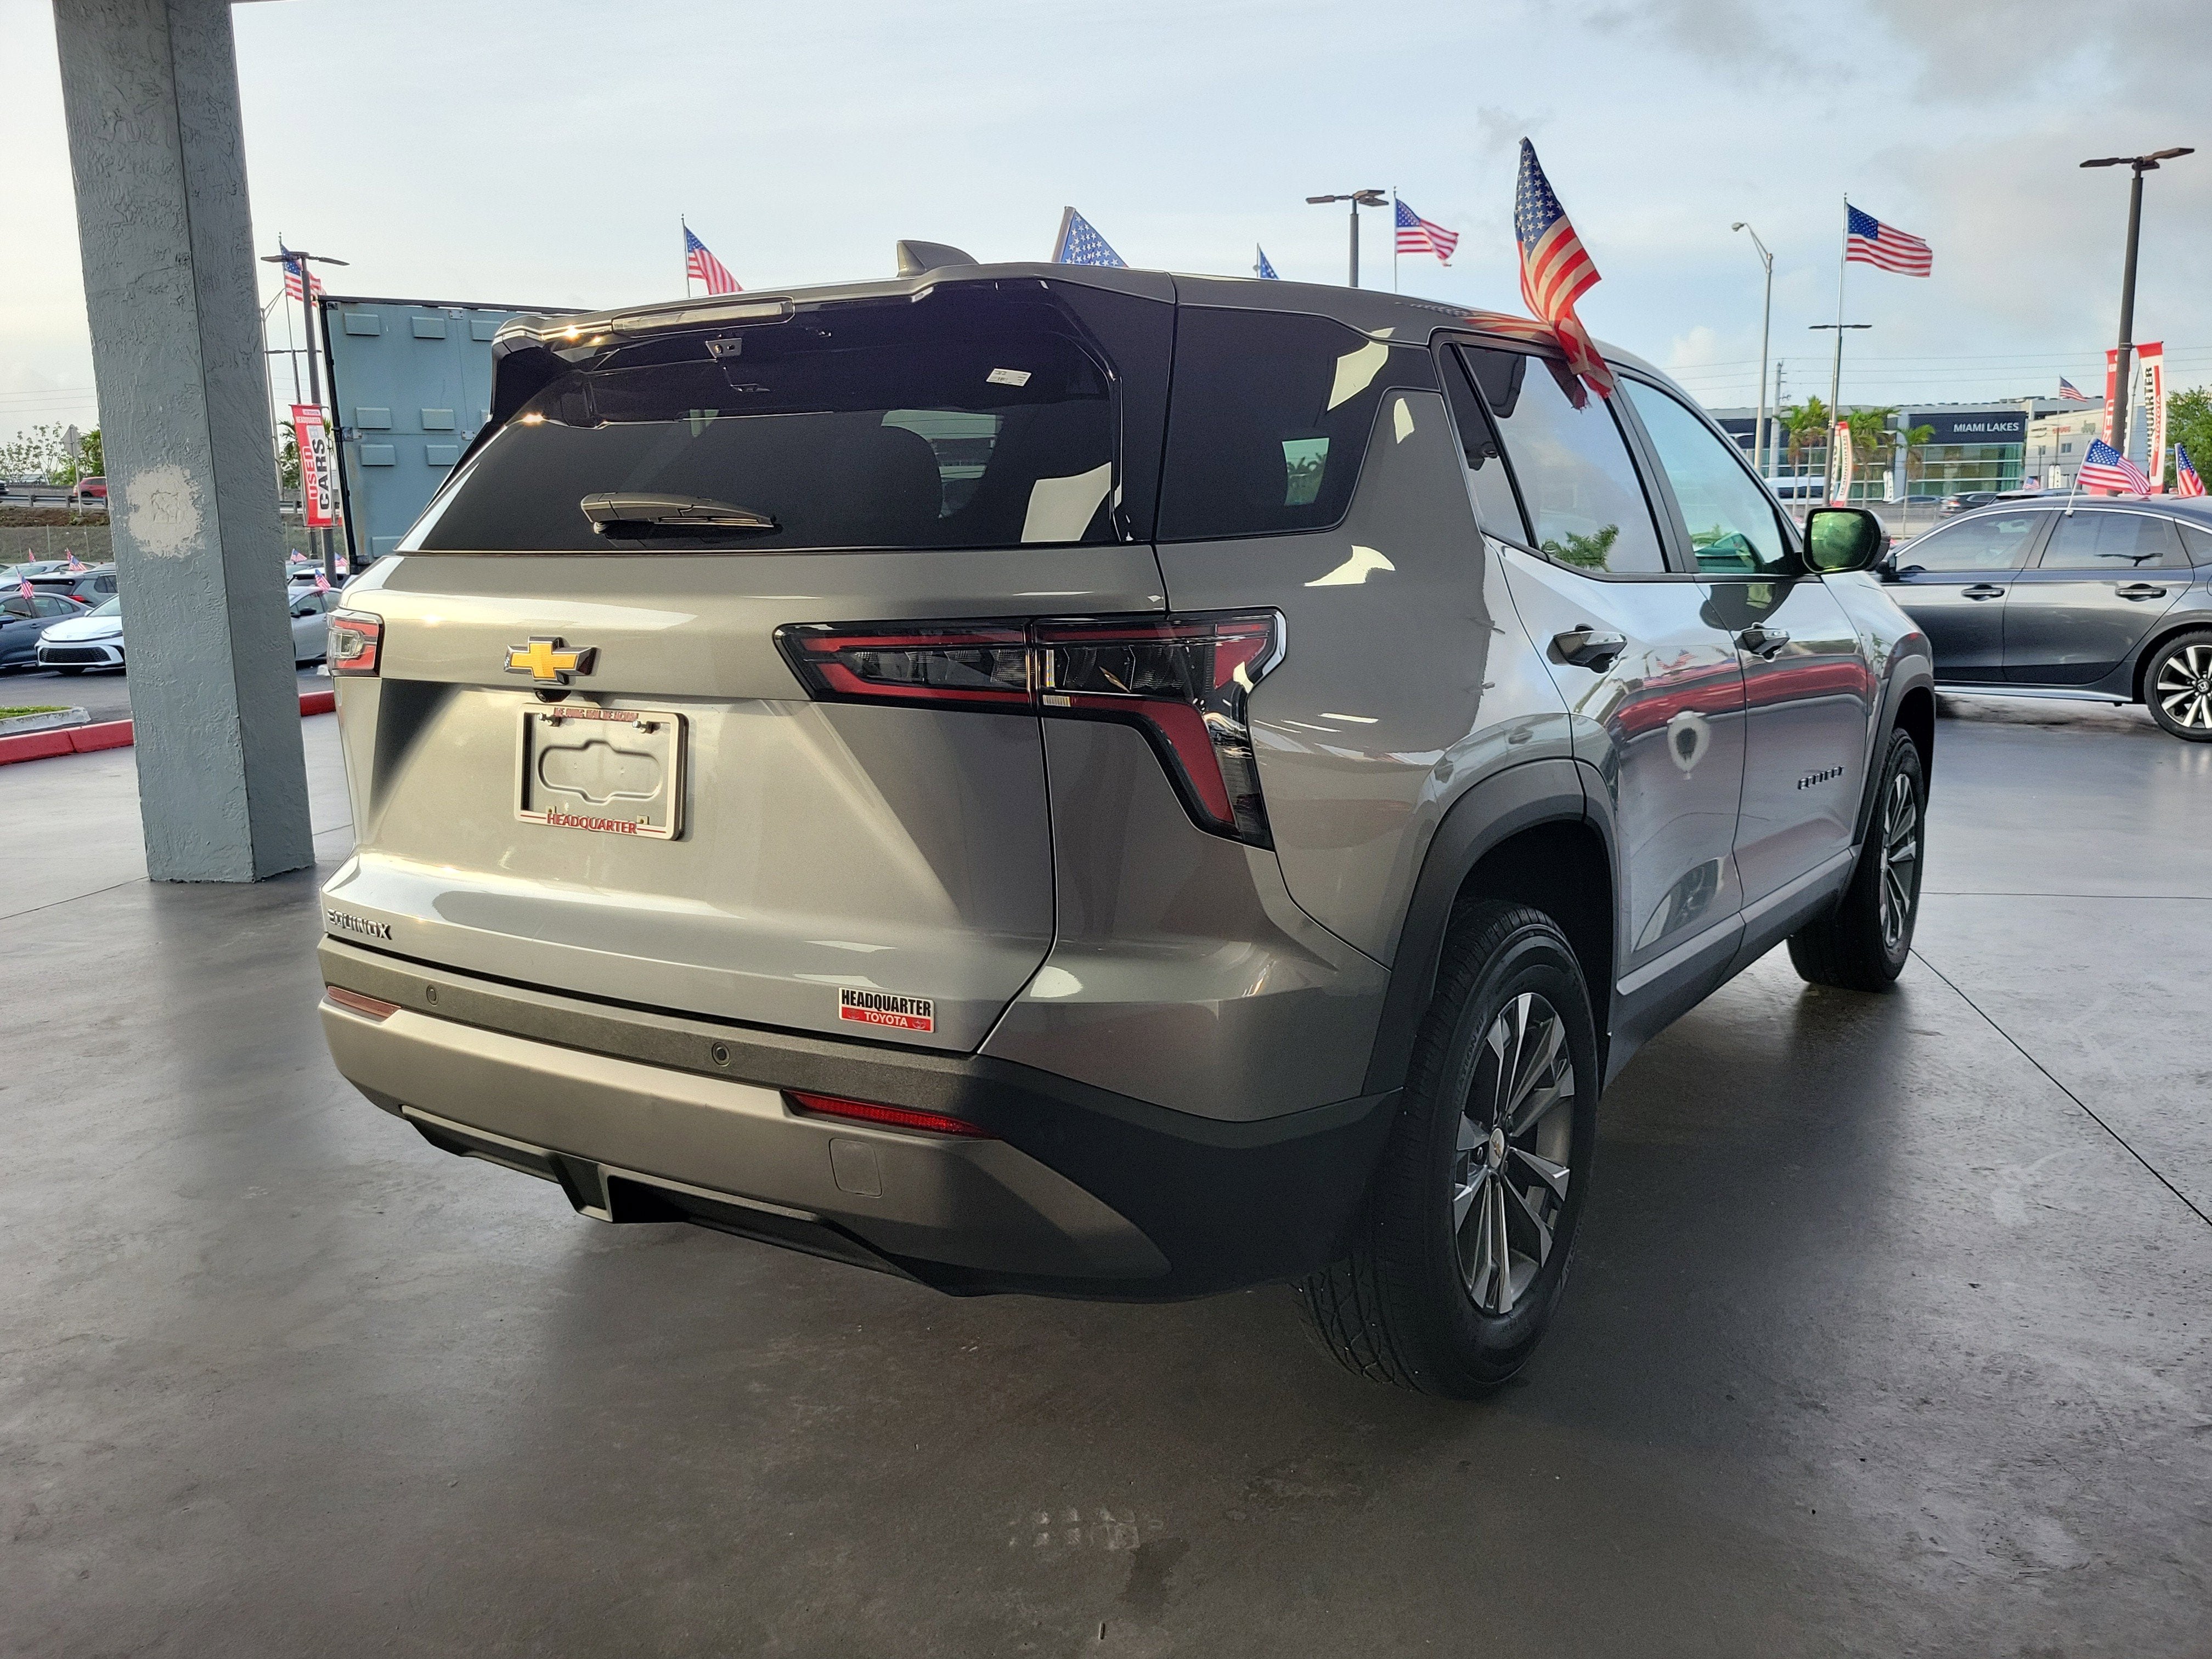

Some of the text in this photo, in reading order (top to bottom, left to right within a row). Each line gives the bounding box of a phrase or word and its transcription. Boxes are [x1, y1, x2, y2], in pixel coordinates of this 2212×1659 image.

[1953, 423, 1984, 433] MIAMI
[1986, 422, 2019, 432] LAKES
[303, 446, 318, 499] USED
[312, 438, 328, 510] CARS
[547, 813, 637, 834] HEADQUARTER
[328, 909, 392, 940] EQUINOX
[842, 989, 932, 1017] HEADQUARTER
[864, 1011, 909, 1027] TOYOTA
